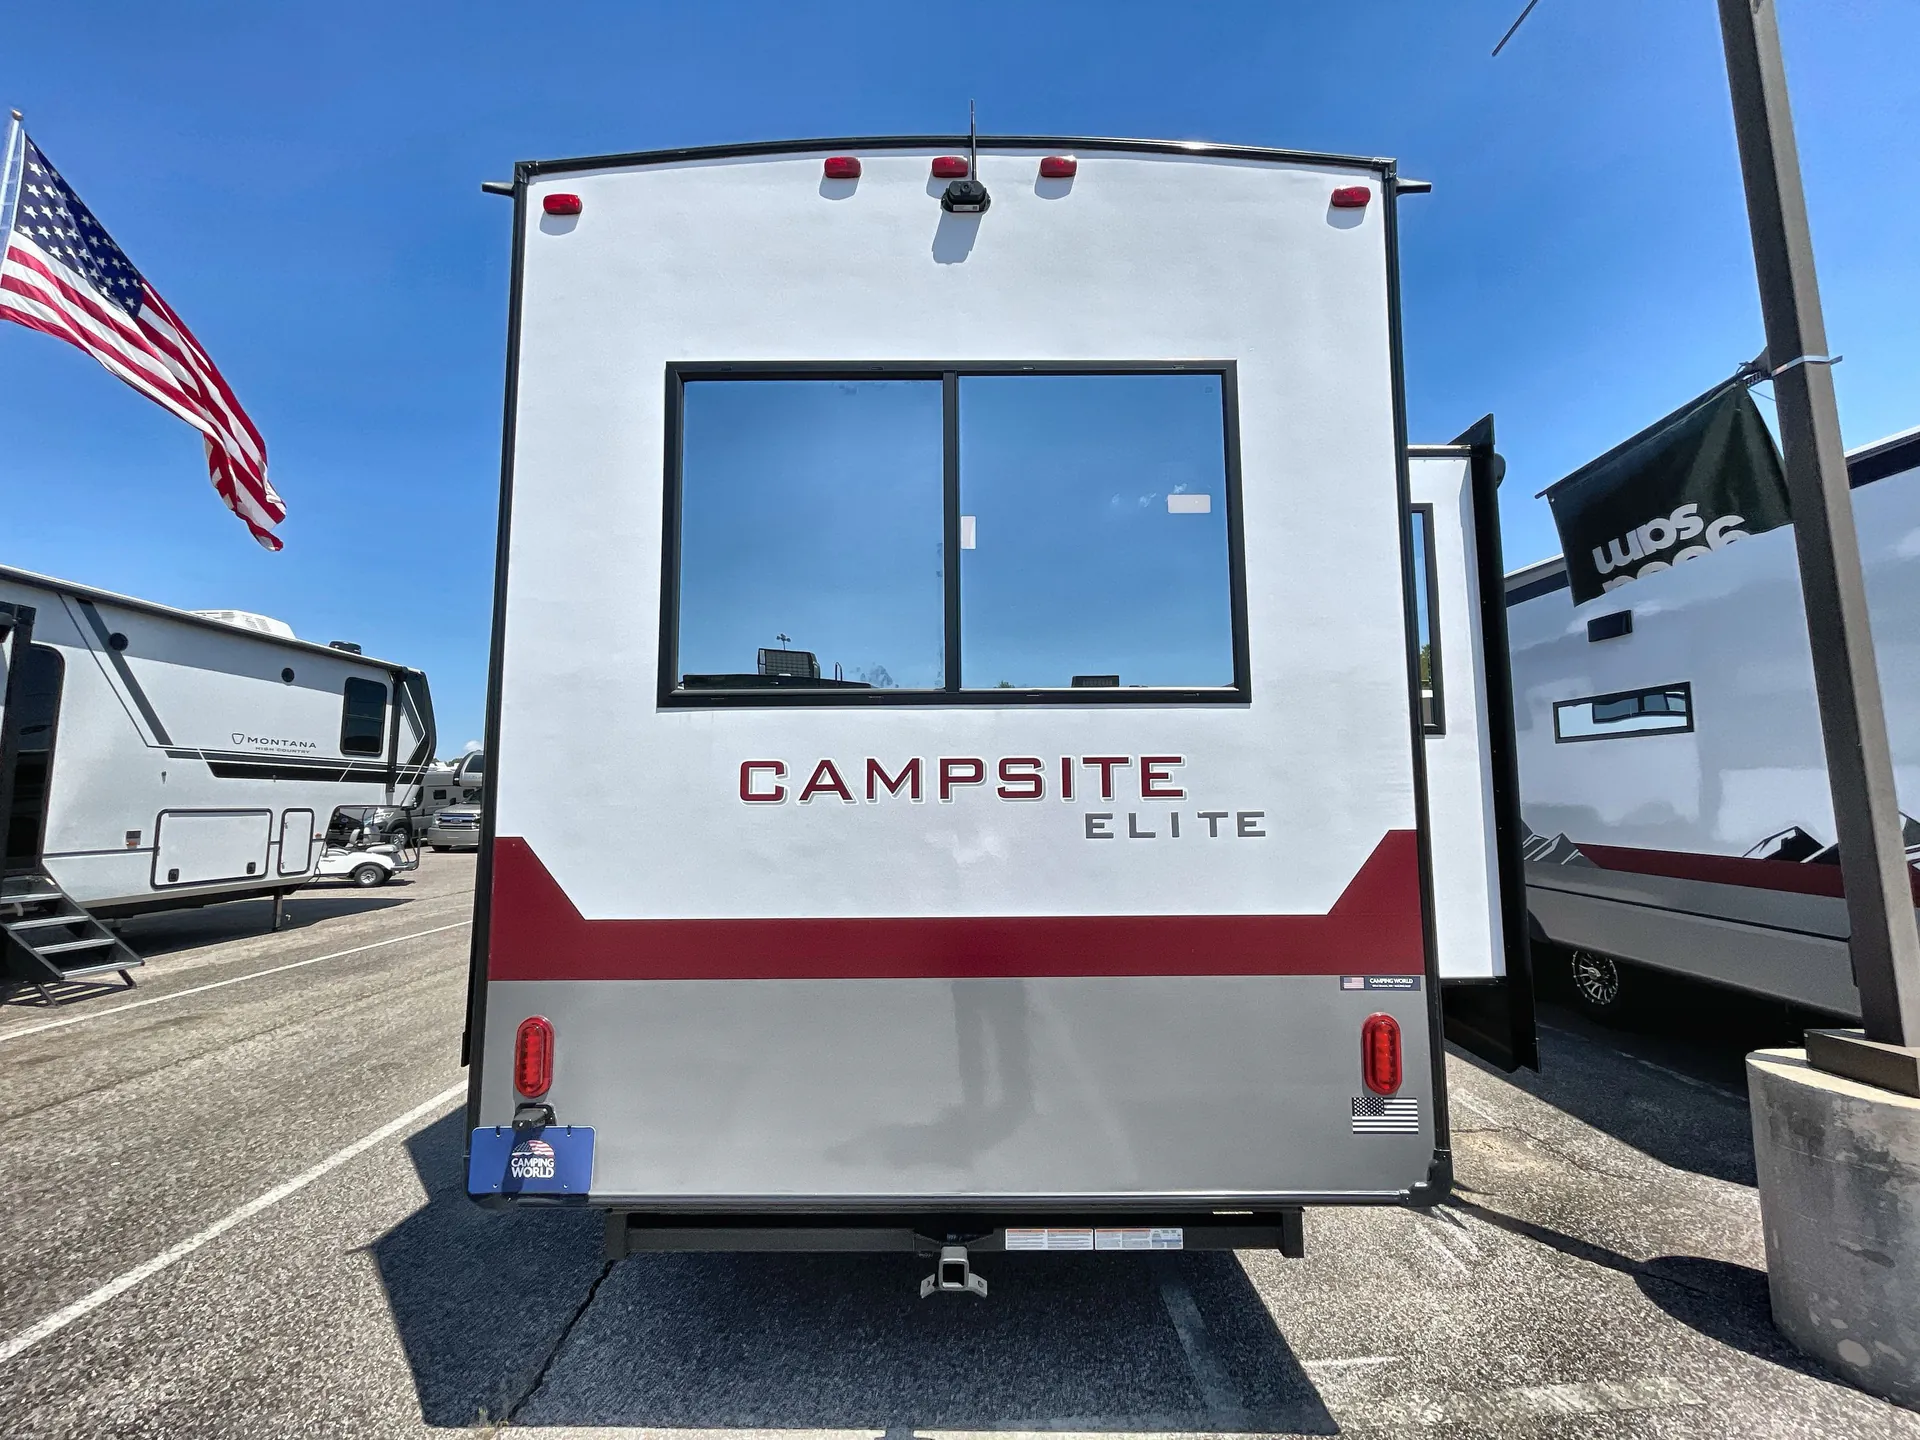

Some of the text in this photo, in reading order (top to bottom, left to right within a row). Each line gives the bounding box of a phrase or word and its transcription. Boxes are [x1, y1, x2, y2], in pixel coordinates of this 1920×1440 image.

[248, 737, 316, 749] MONTANA
[739, 754, 1187, 805] CAMPSITE
[1085, 810, 1266, 839] ELITE
[511, 1158, 554, 1168] CAMPING
[511, 1167, 554, 1178] WORLD
